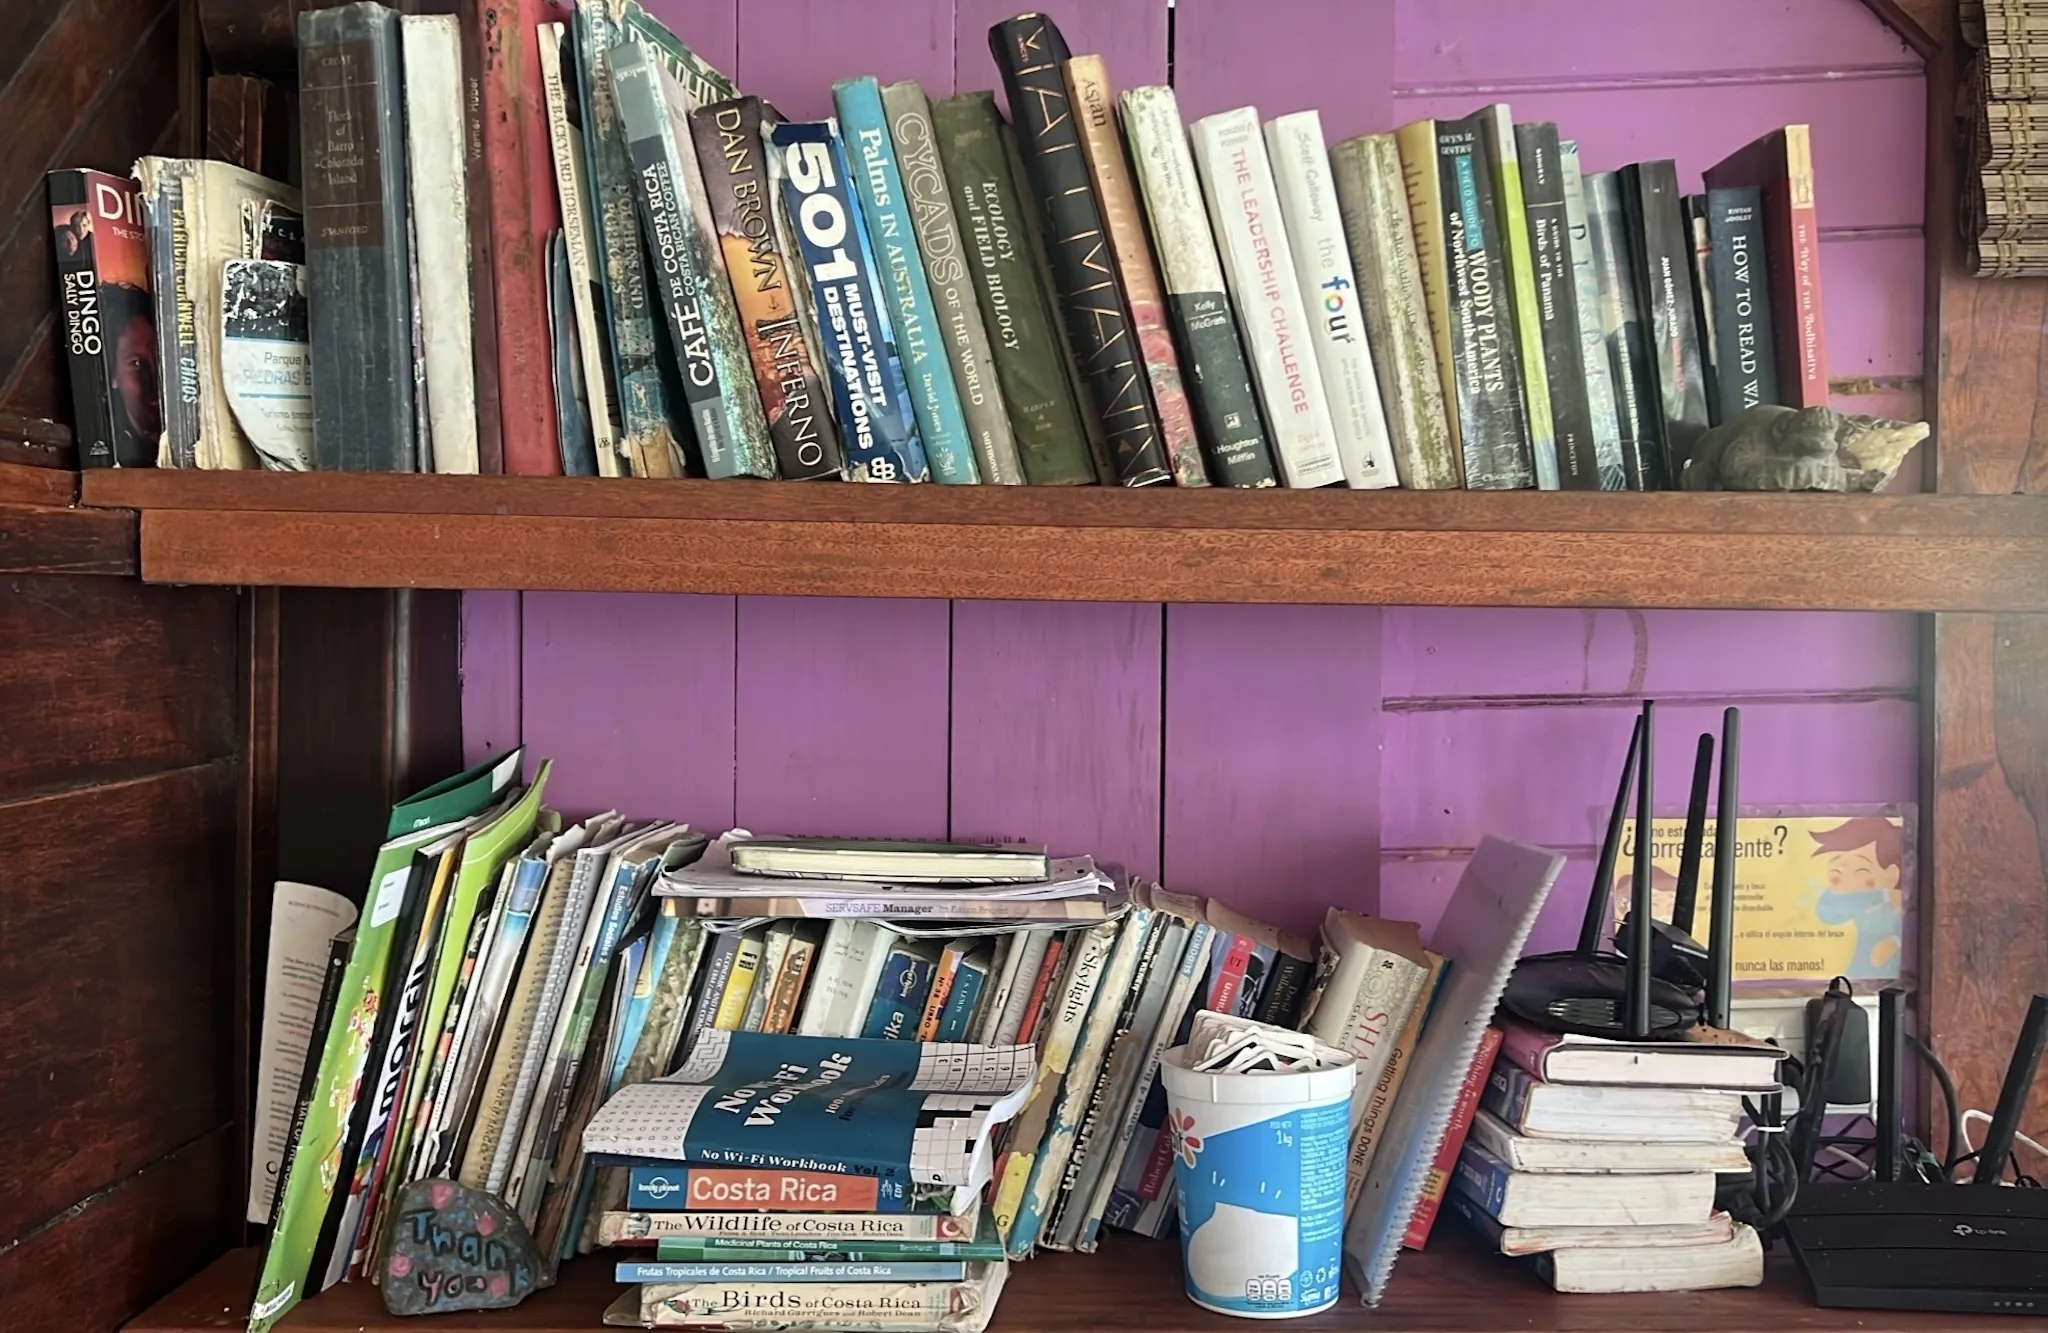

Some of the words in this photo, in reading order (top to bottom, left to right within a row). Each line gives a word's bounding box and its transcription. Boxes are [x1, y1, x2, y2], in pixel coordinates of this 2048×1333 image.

[547, 72, 561, 103] THE
[1082, 77, 1107, 128] Asian
[327, 110, 351, 123] Flora
[336, 125, 346, 136] of
[327, 141, 354, 152] Barro
[470, 118, 481, 160] Werner
[551, 105, 573, 181] BACKYARD
[715, 107, 752, 175] DAN
[319, 157, 364, 169] Colorado
[859, 127, 890, 207] Palms
[1297, 131, 1310, 165] Scott
[1304, 168, 1323, 222] Galloway
[642, 164, 664, 208] RICA
[655, 160, 676, 210] COFFEE
[895, 112, 964, 285] CYCADS
[964, 186, 981, 212] and
[562, 182, 586, 267] HORSEMAN
[785, 142, 858, 282] 501
[880, 213, 899, 238] IN
[982, 181, 1016, 262] ECOLOGY
[1450, 212, 1463, 228] of
[1465, 199, 1476, 229] GUIDE
[321, 225, 369, 237] STANFORD
[654, 209, 681, 274] COSTA
[668, 213, 689, 251] RICAN
[733, 180, 781, 293] BROWN
[971, 215, 996, 268] FIELD
[1536, 219, 1548, 251] Birds
[1317, 237, 1335, 269] the
[1452, 229, 1470, 297] Northwest
[1540, 255, 1549, 269] of
[1661, 256, 1671, 278] JUAN
[1732, 235, 1750, 284] HOW
[1799, 246, 1810, 272] Way
[63, 273, 80, 306] SALLY
[627, 275, 643, 309] AND
[670, 277, 684, 298] DE
[677, 252, 696, 297] COSTA
[1231, 148, 1251, 185] THE
[1241, 187, 1280, 304] LEADERSHIP
[1270, 303, 1309, 415] CHALLENGE
[1467, 250, 1494, 320] WOODY
[1801, 273, 1810, 287] of
[76, 270, 102, 355] DINGO
[887, 243, 928, 365] AUSTRALIA
[945, 287, 961, 309] OF
[985, 273, 1020, 351] BIOLOGY
[1194, 299, 1216, 312] Kelly
[1322, 276, 1353, 343] four
[1541, 272, 1555, 321] Panama
[1736, 288, 1753, 317] TO
[67, 309, 84, 355] DINGO
[951, 314, 969, 346] THE
[1190, 315, 1227, 332] McGrath
[1460, 299, 1476, 337] South
[264, 351, 301, 368] Parque
[671, 298, 714, 387] CAFÉ
[844, 283, 888, 406] MUST-VISIT
[1478, 320, 1504, 393] PLANTS
[1738, 323, 1757, 375] READ
[1804, 313, 1819, 380] Bodhisattva
[179, 357, 198, 404] CHAOS
[823, 286, 873, 450] DESTINATIONS
[959, 348, 984, 406] WORLD
[1466, 338, 1481, 394] America
[756, 318, 823, 467] INFERNO
[922, 373, 937, 404] David
[1743, 379, 1760, 410] WA
[981, 430, 1001, 483] SMITHSONIAN
[1216, 438, 1260, 455] Houghton
[1227, 451, 1256, 465] Mifflin
[611, 884, 630, 922] Estudios
[825, 903, 880, 914] SERVSAFE
[882, 903, 934, 916] Manager
[601, 921, 619, 957] Sociales
[718, 951, 733, 989] ECONOMIC
[1735, 961, 1766, 972] nunca
[1769, 959, 1784, 972] las
[1787, 959, 1825, 972] manos!
[709, 988, 723, 1008] AND
[956, 989, 970, 1013] LEWIS
[1063, 951, 1099, 1024] Skylights
[924, 1004, 936, 1028] LIBRO
[1376, 1048, 1403, 1091] Getting
[1469, 1045, 1493, 1089] Nothing
[714, 1087, 757, 1114] No
[1122, 1097, 1140, 1142] Games
[1145, 1041, 1166, 1084] Brains
[1364, 1094, 1387, 1135] Things
[1449, 1100, 1469, 1131] worth
[701, 1150, 720, 1161] No
[724, 1151, 765, 1165] Wi-Fi
[768, 1155, 847, 1174] Workbook
[853, 1165, 880, 1178] Vol.
[884, 1168, 895, 1177] 2
[1351, 1136, 1372, 1168] DONE
[638, 1182, 658, 1194] lonely
[658, 1183, 680, 1195] planet
[693, 1176, 771, 1202] Costa
[780, 1177, 837, 1202] Rica
[1144, 1160, 1163, 1194] Robert
[654, 1220, 683, 1230] The
[684, 1215, 782, 1231] Wildlife
[786, 1222, 800, 1231] of
[803, 1219, 860, 1232] Costa
[861, 1219, 904, 1232] Rica
[715, 1239, 755, 1248] Medicinal
[756, 1239, 781, 1248] Plants
[782, 1240, 792, 1248] of
[793, 1240, 817, 1249] Costa
[819, 1241, 838, 1249] Rica
[637, 1267, 663, 1276] Frutas
[665, 1267, 707, 1279] Tropicales
[709, 1267, 720, 1276] de
[722, 1267, 746, 1276] Costa
[748, 1267, 766, 1276] Rica
[775, 1266, 808, 1277] Tropical
[810, 1266, 834, 1275] Fruits
[835, 1266, 845, 1275] of
[846, 1266, 871, 1275] Costa
[873, 1266, 892, 1275] Rica
[692, 1298, 718, 1308] The
[722, 1290, 801, 1309] Birds
[806, 1298, 820, 1308] of
[821, 1297, 872, 1309] Costa
[879, 1297, 921, 1309] Rica
[744, 1309, 785, 1317] Richard
[858, 1309, 892, 1317] Robert
